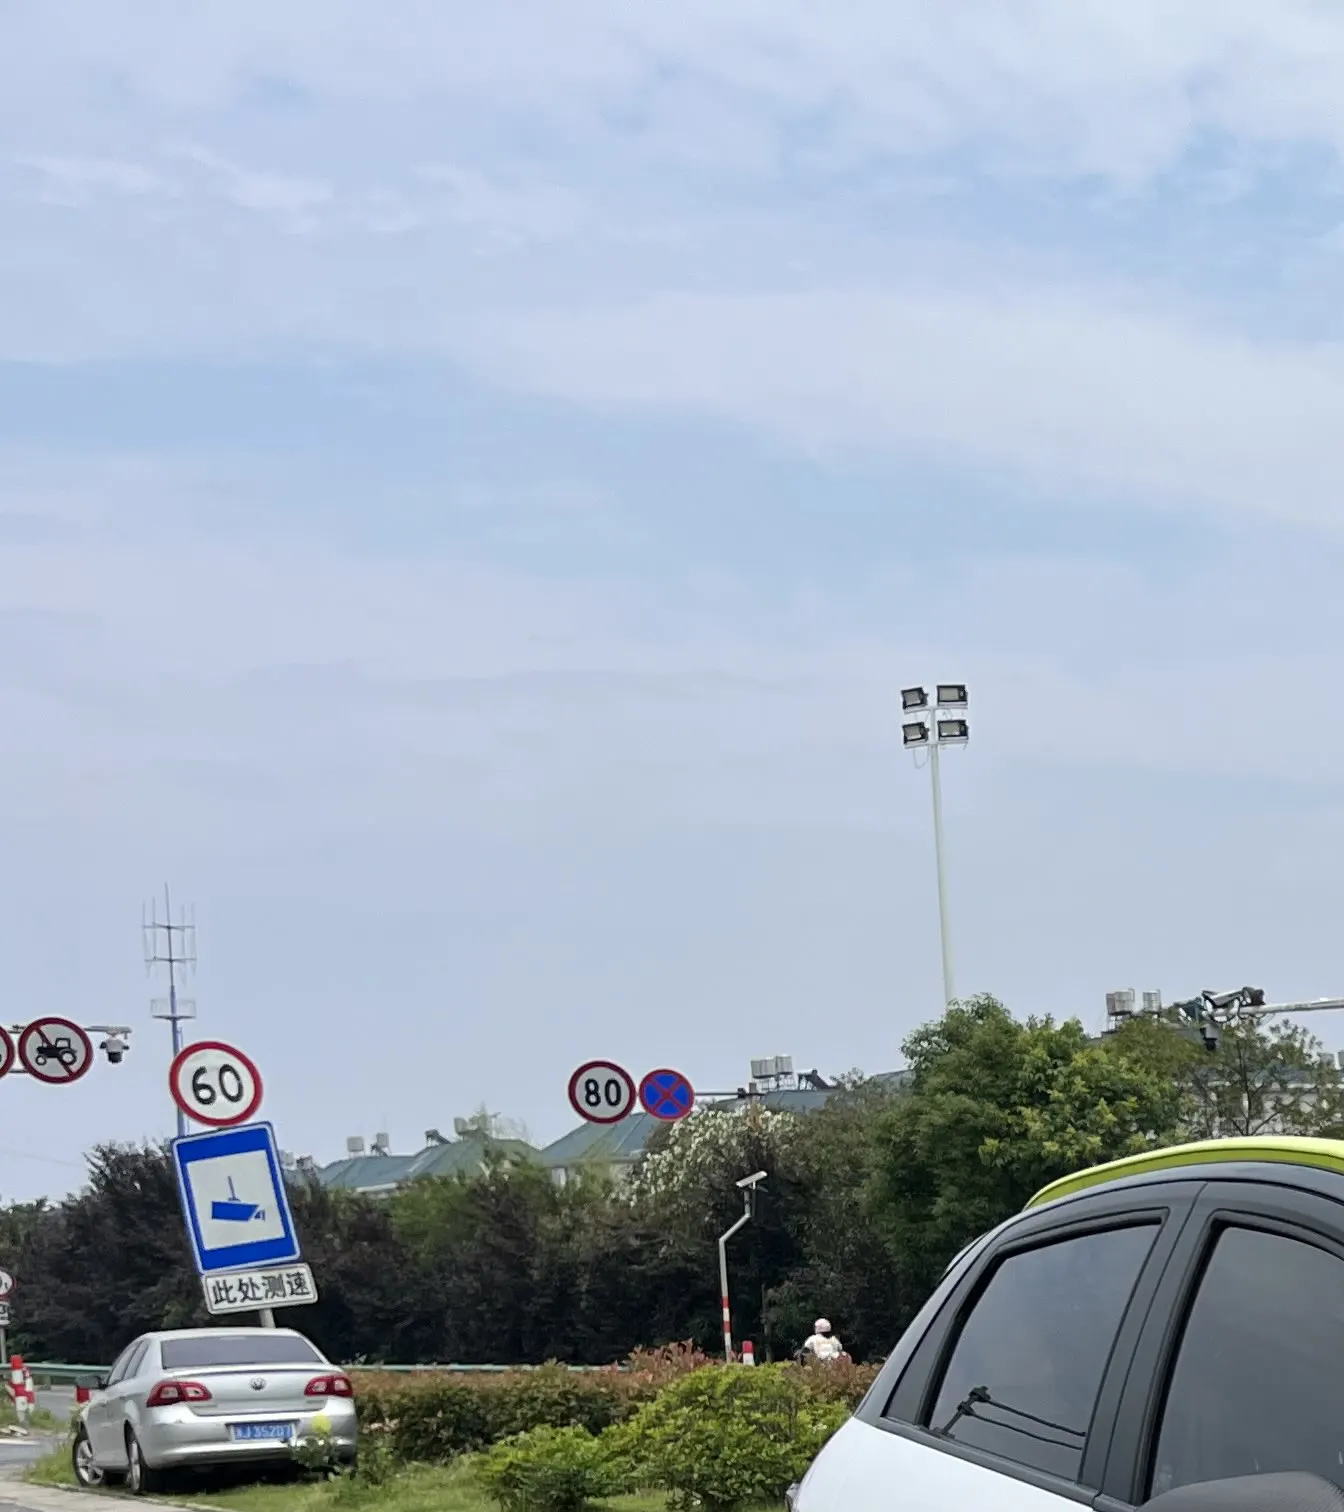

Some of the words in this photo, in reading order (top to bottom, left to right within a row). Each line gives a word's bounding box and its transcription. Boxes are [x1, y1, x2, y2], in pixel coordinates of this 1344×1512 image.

[192, 1064, 244, 1105] 60
[585, 1078, 622, 1107] 80
[212, 1272, 310, 1304] 此处测速
